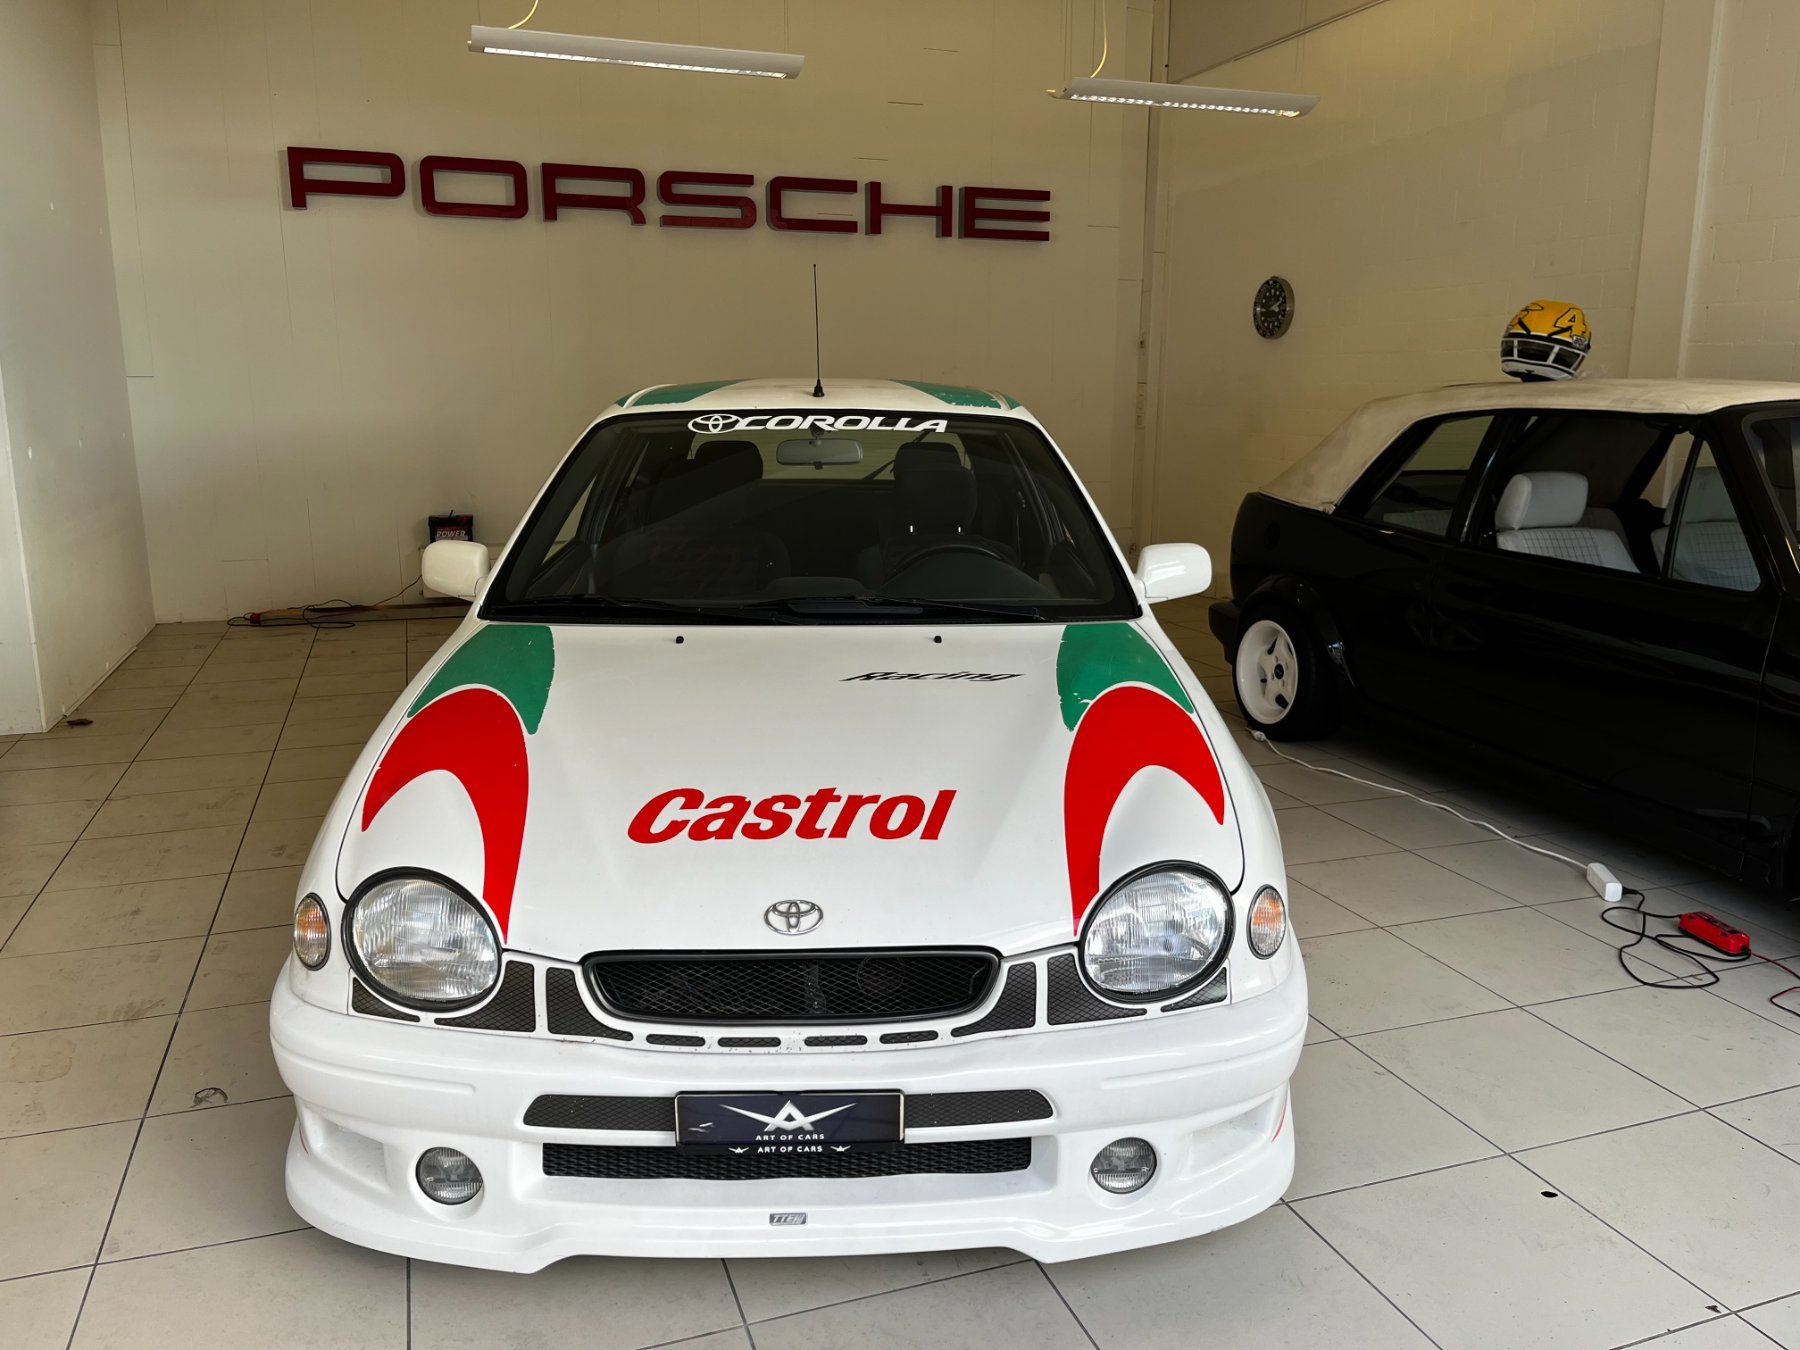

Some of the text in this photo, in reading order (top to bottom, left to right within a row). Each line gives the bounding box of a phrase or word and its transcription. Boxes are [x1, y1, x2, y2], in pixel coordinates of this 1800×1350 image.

[286, 145, 1051, 242] PORSCHE
[734, 415, 949, 433] COROLLA
[839, 671, 1025, 682] Racing
[627, 787, 957, 844] Castrol
[797, 1133, 825, 1141] CARS
[796, 1145, 823, 1153] CARS
